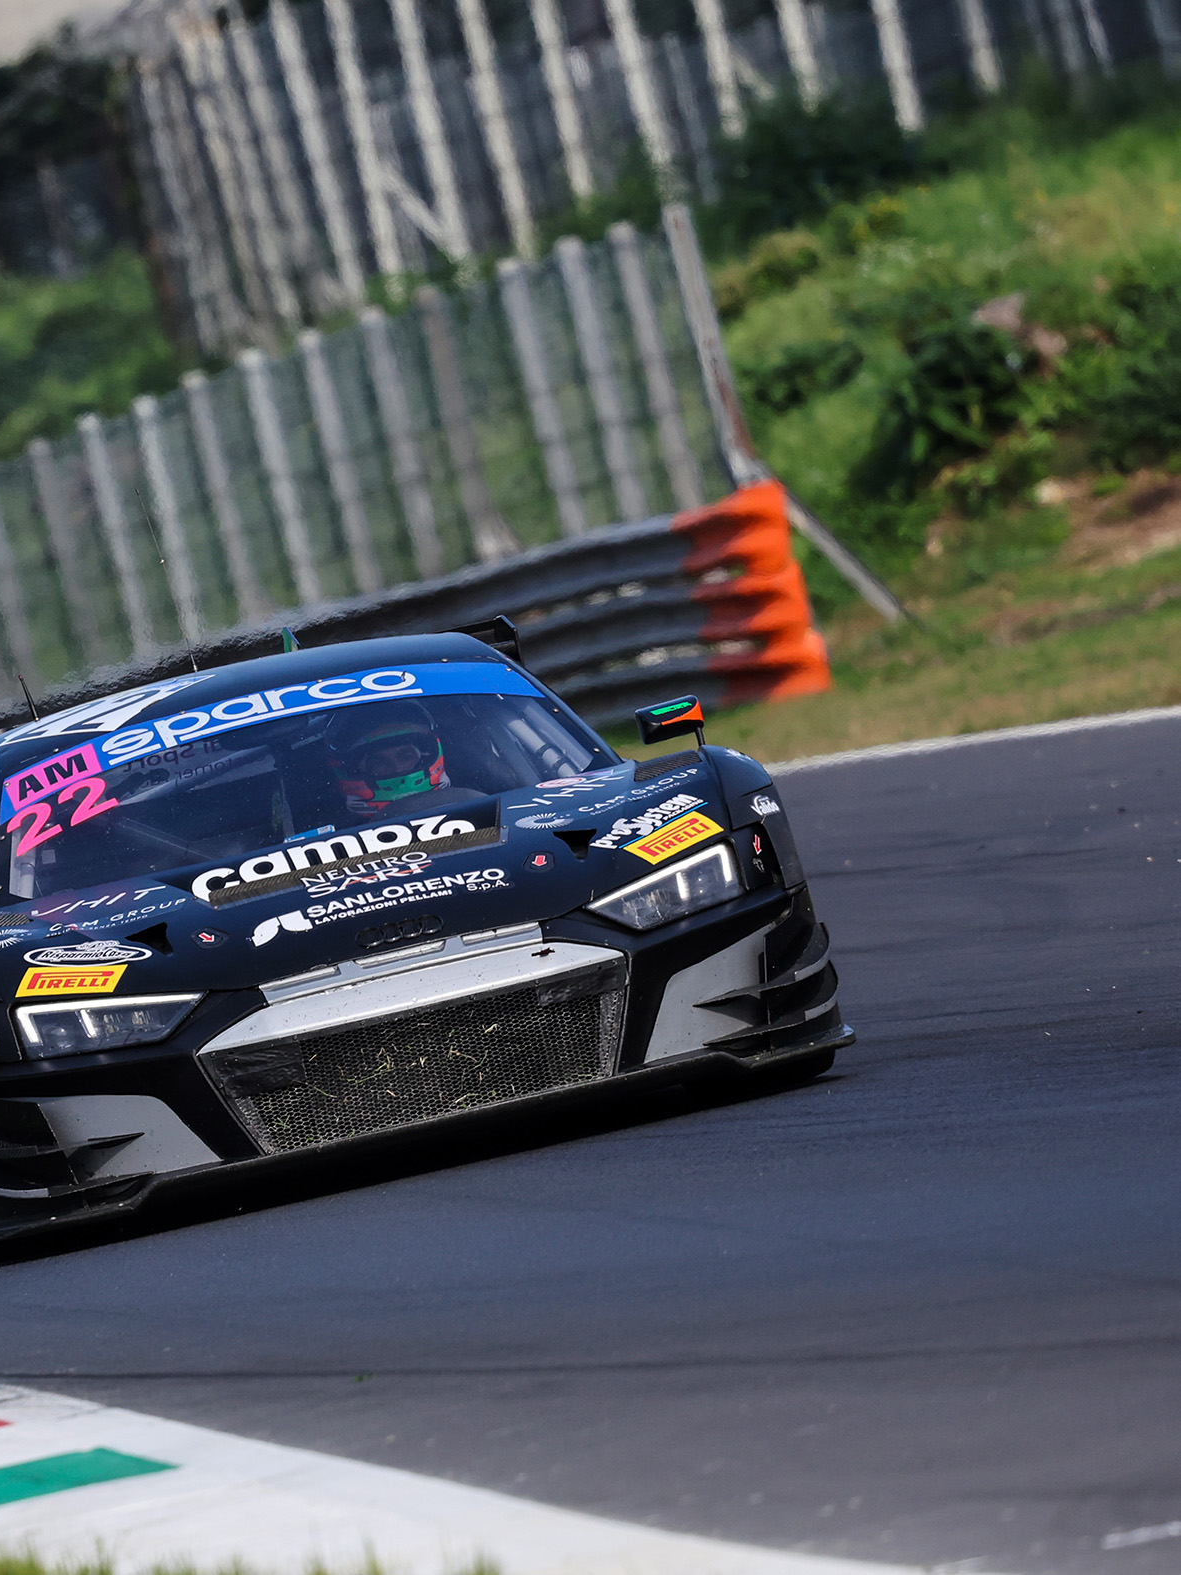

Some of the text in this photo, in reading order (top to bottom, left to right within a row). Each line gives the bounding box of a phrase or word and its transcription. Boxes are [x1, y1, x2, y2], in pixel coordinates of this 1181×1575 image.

[102, 671, 422, 766] sparco
[18, 753, 88, 802] AM
[578, 768, 698, 813] CAM GROUP
[6, 777, 119, 858] 22
[637, 817, 710, 858] PIRELLI
[301, 851, 429, 889] NEUTRO
[110, 898, 186, 921] GROUP
[306, 868, 505, 919] SANLORENZO
[315, 889, 453, 926] LAVORAZIONI PELLAMI
[27, 971, 114, 990] PIRELLI
